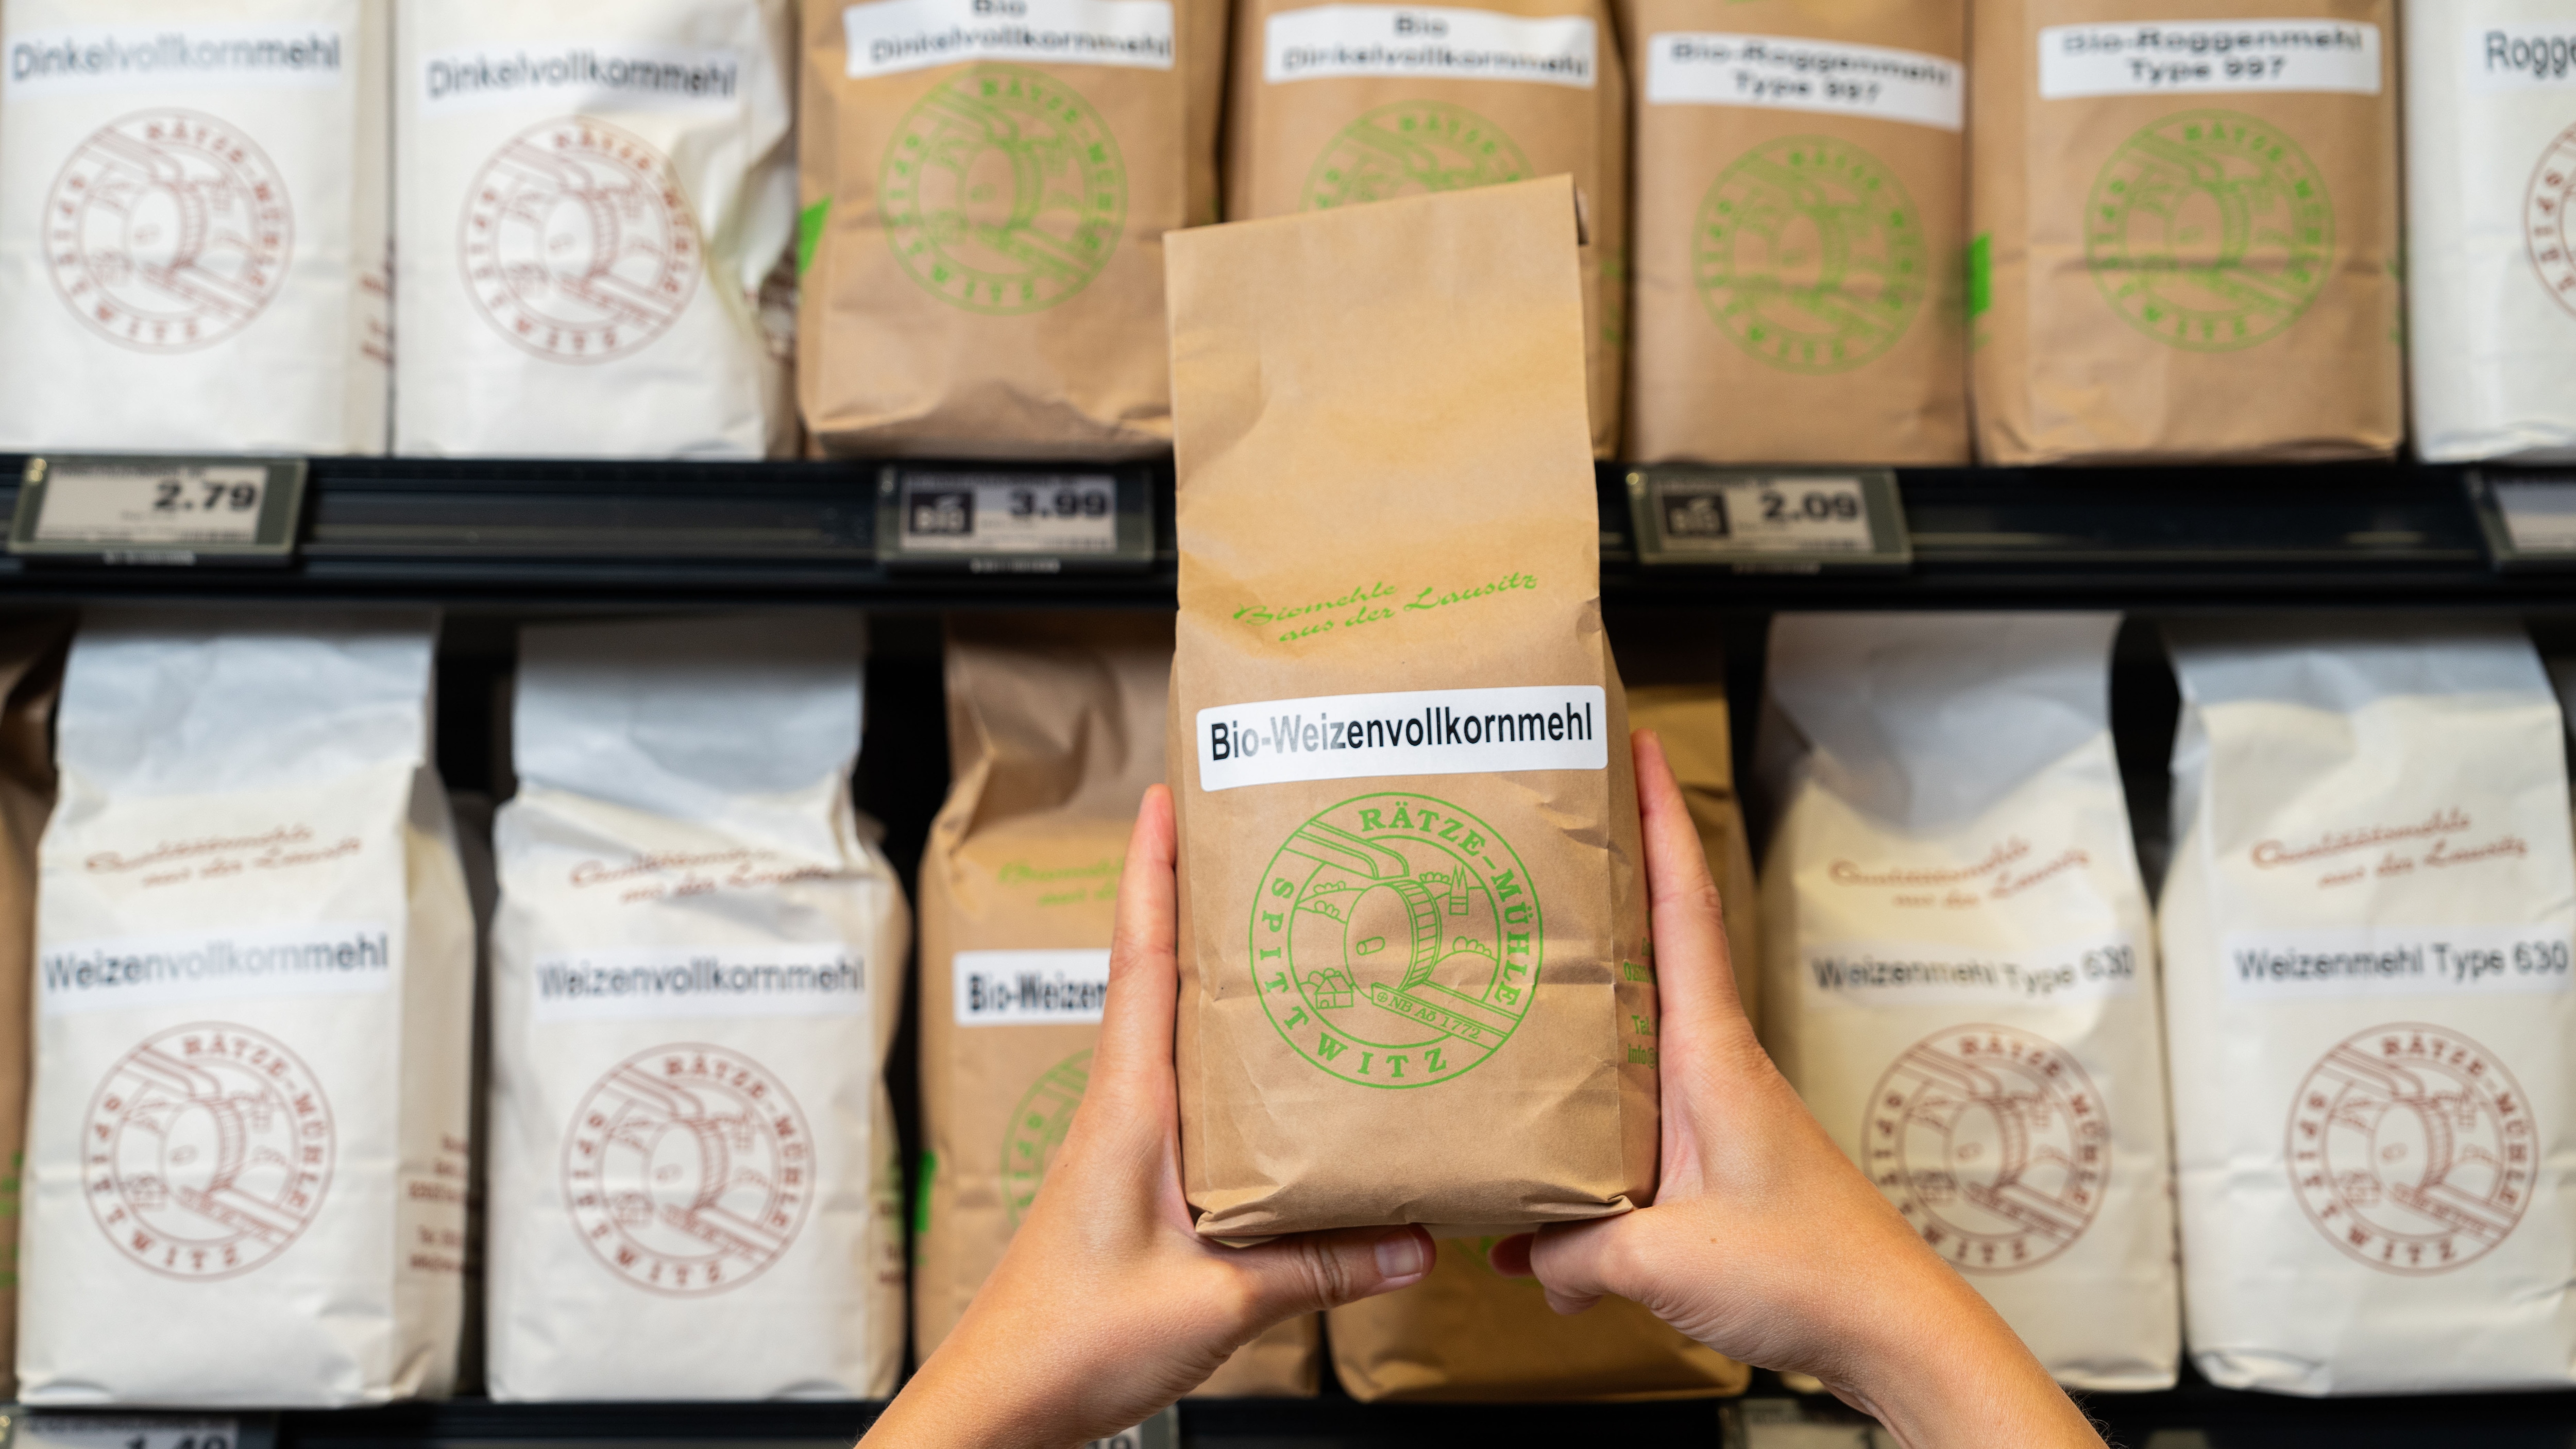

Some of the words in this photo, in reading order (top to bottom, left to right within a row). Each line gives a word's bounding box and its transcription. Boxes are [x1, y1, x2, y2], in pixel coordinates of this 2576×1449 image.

[870, 26, 1172, 63] Dinkelvollkornmehl
[1394, 11, 1449, 38] Bio
[13, 32, 341, 81] Dinkelvollkornmehl
[426, 50, 738, 100] Dinkelvollkornmehl
[2125, 57, 2212, 84] Type
[2224, 56, 2289, 80] 997
[155, 478, 256, 512] 2.79
[1011, 488, 1107, 520] 3.99
[1762, 490, 1858, 521] 2.09
[1232, 581, 1398, 626] Biomehle
[1278, 620, 1335, 642] aus
[1345, 606, 1396, 627] der
[1403, 572, 1538, 611] Lausitz
[1211, 702, 1593, 761] Bio-Weizenvollkornmehl
[1358, 801, 1534, 1006] RÄTZE-MÜHLE
[45, 933, 389, 992] Weizenvollkornmehl
[537, 956, 865, 998] Weizenvollkornmehl
[1260, 877, 1447, 1078] SPITTWITZ
[2235, 945, 2423, 981] Weizenmehl
[2430, 941, 2505, 984] Type
[2513, 939, 2568, 974] 630
[968, 970, 1108, 1012] Bio-Weizen
[1388, 995, 1413, 1013] NB
[1440, 1016, 1481, 1039] 1772
